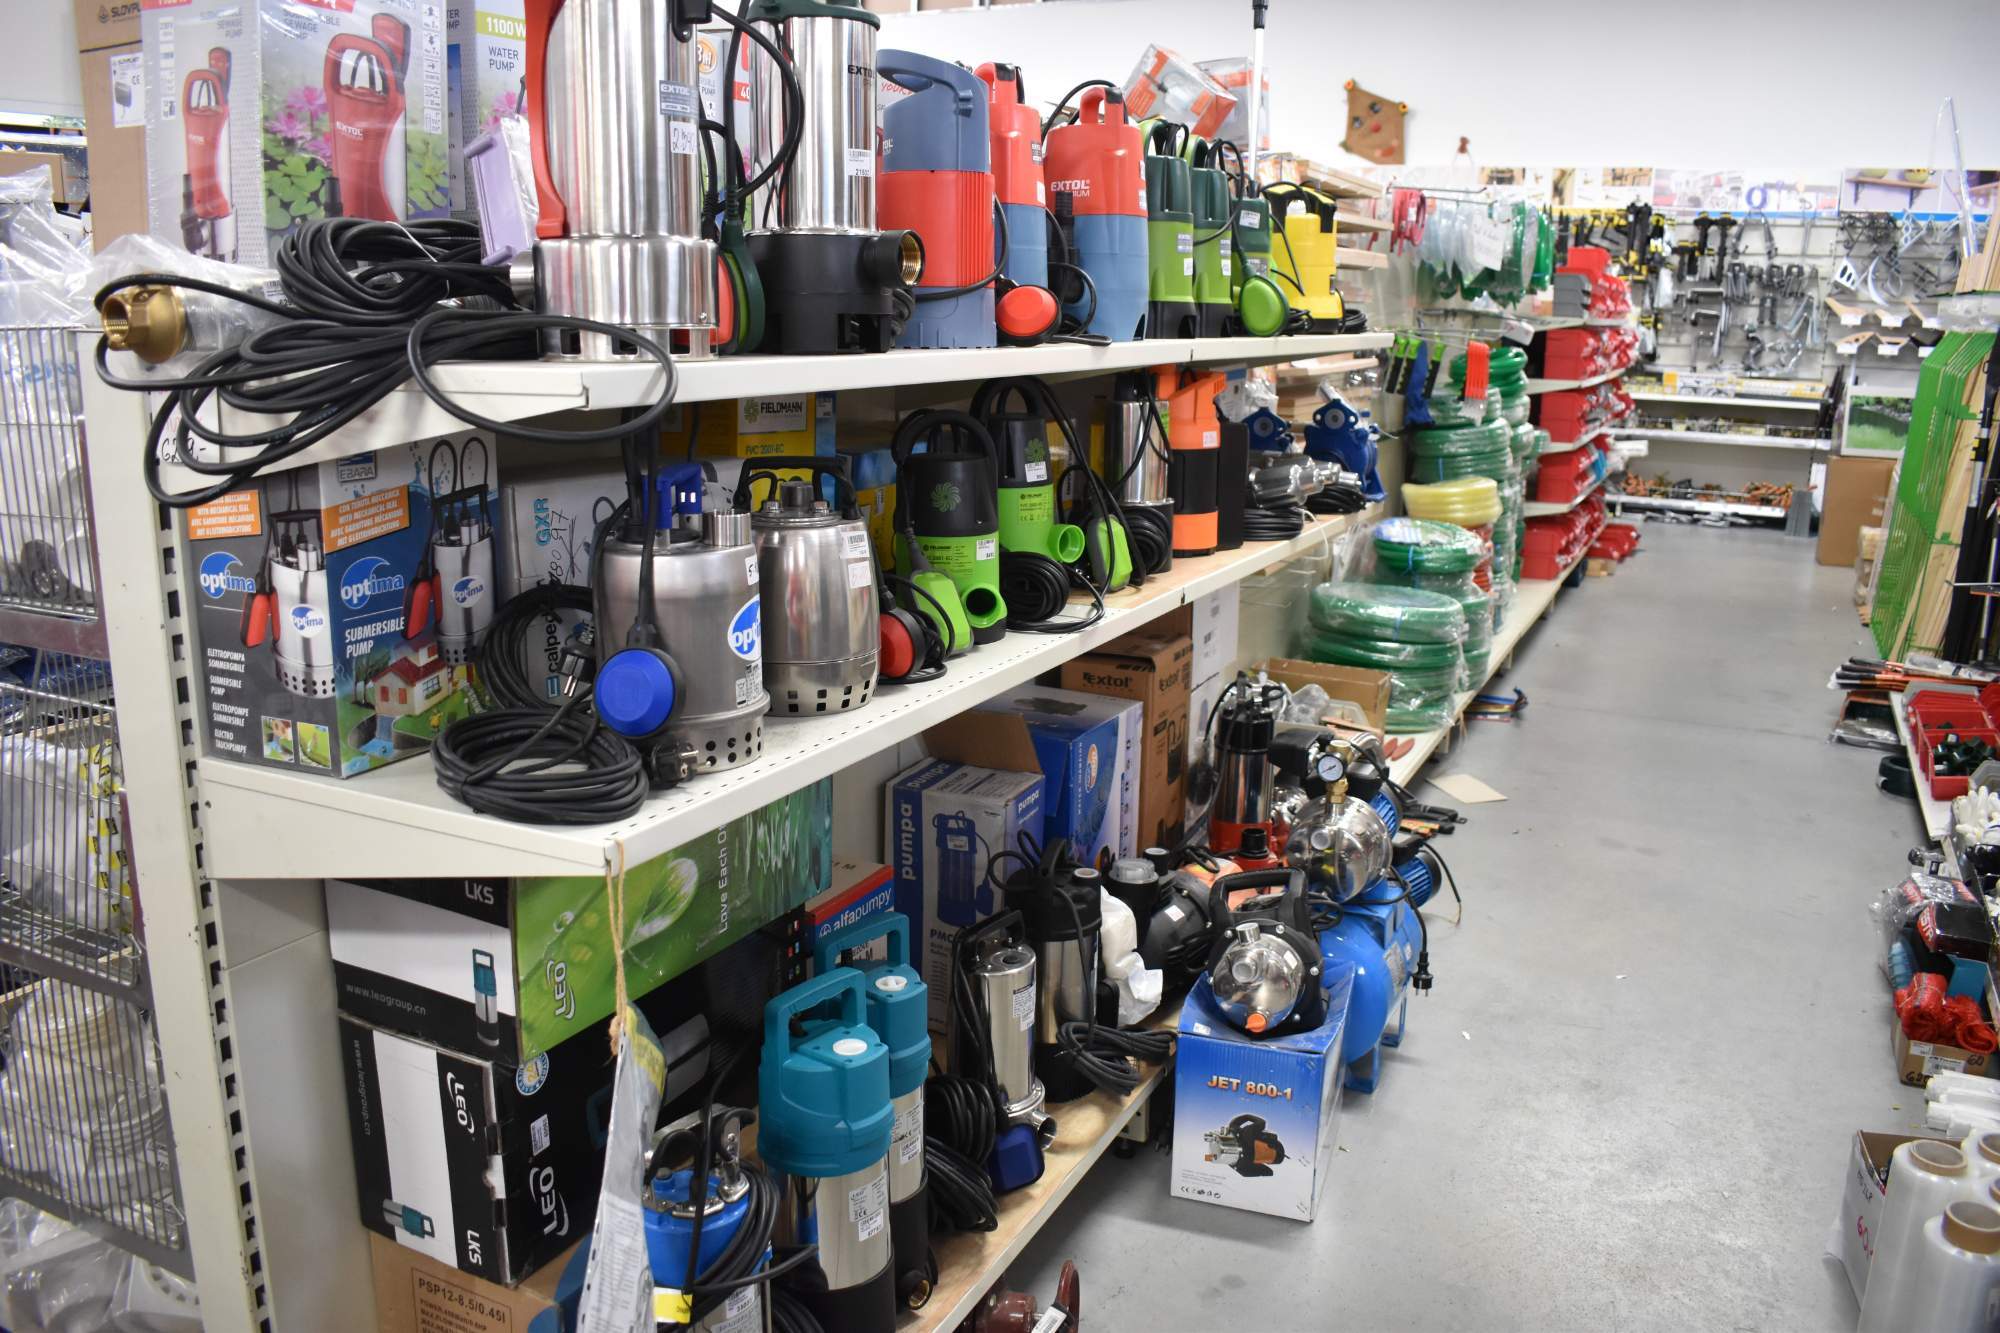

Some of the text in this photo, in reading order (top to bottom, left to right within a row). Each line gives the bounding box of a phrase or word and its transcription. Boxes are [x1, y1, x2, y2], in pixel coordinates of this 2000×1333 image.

[487, 17, 513, 35] 1100
[488, 45, 519, 60] WATER
[489, 59, 515, 72] PUMP
[1051, 179, 1090, 191] EXTOL
[761, 401, 803, 414] FIELDMANN
[340, 466, 374, 480] EBARA
[533, 498, 551, 546] GXR
[200, 570, 256, 593] optima
[341, 573, 405, 604] optima
[454, 583, 483, 602] optima
[292, 612, 324, 631] optima
[345, 616, 405, 643] SUBMERSIBLE
[346, 639, 374, 658] PUMP
[210, 674, 242, 688] SUBMERSIBLE
[210, 686, 225, 696] PUMP
[1082, 671, 1131, 688] Extol
[906, 763, 950, 789] pumpa
[1017, 789, 1040, 814] pumpa
[901, 803, 917, 881] pumpa
[718, 856, 728, 894] Each
[464, 880, 494, 905] LKS
[718, 897, 728, 935] Love
[833, 887, 892, 932] alfapumpy
[345, 983, 427, 1016] www.leogroup.cn
[1207, 1075, 1293, 1101] JET 800-1
[467, 1228, 482, 1267] LKS
